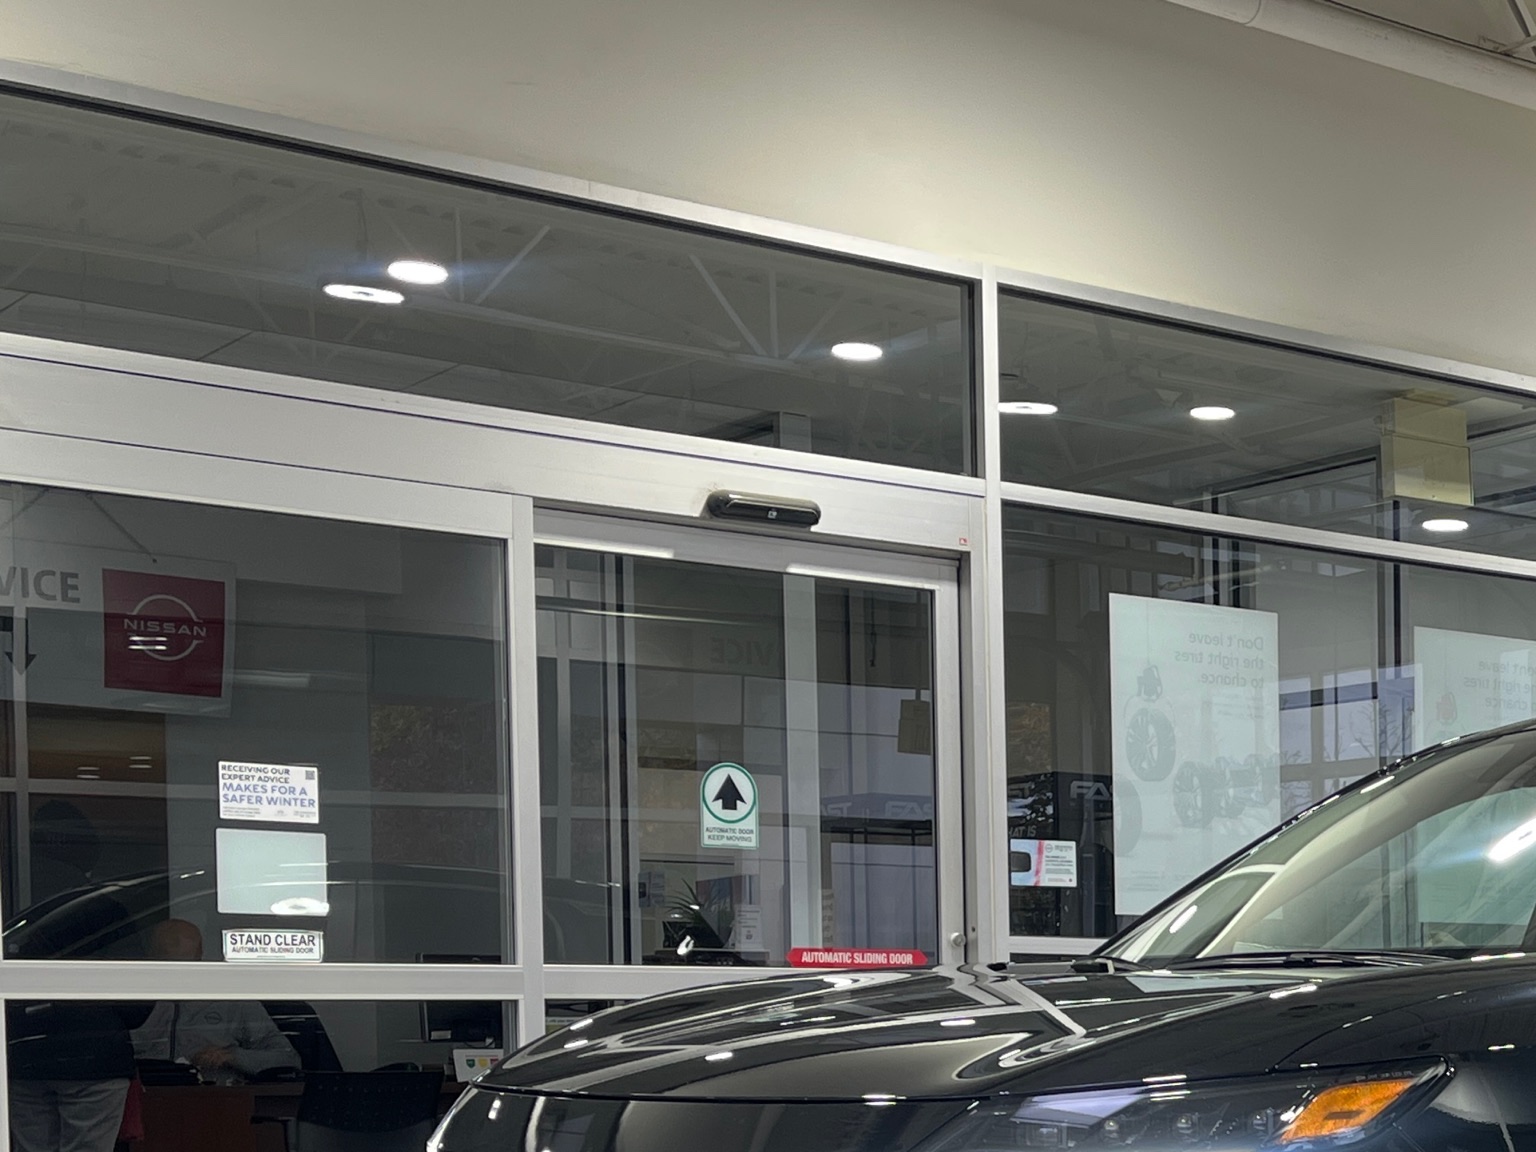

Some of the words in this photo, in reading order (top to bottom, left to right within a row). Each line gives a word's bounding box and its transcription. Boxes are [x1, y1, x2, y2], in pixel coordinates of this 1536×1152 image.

[123, 618, 207, 637] NISSAN
[221, 764, 269, 774] RECEIVING
[270, 767, 291, 775] OUR
[221, 773, 256, 781] EXPERT
[257, 775, 290, 784] ADVICE
[222, 782, 268, 794] MAKES
[271, 785, 296, 796] FOR
[298, 786, 308, 796] A
[222, 793, 263, 805] SAFER
[266, 796, 316, 808] WINTER
[229, 933, 272, 946] STAND
[274, 934, 316, 947] CLEAR
[270, 946, 294, 954] SLIDING
[801, 951, 852, 964] AUTOMATIC
[853, 952, 887, 964] SLIDING
[889, 953, 913, 965] DOOR
